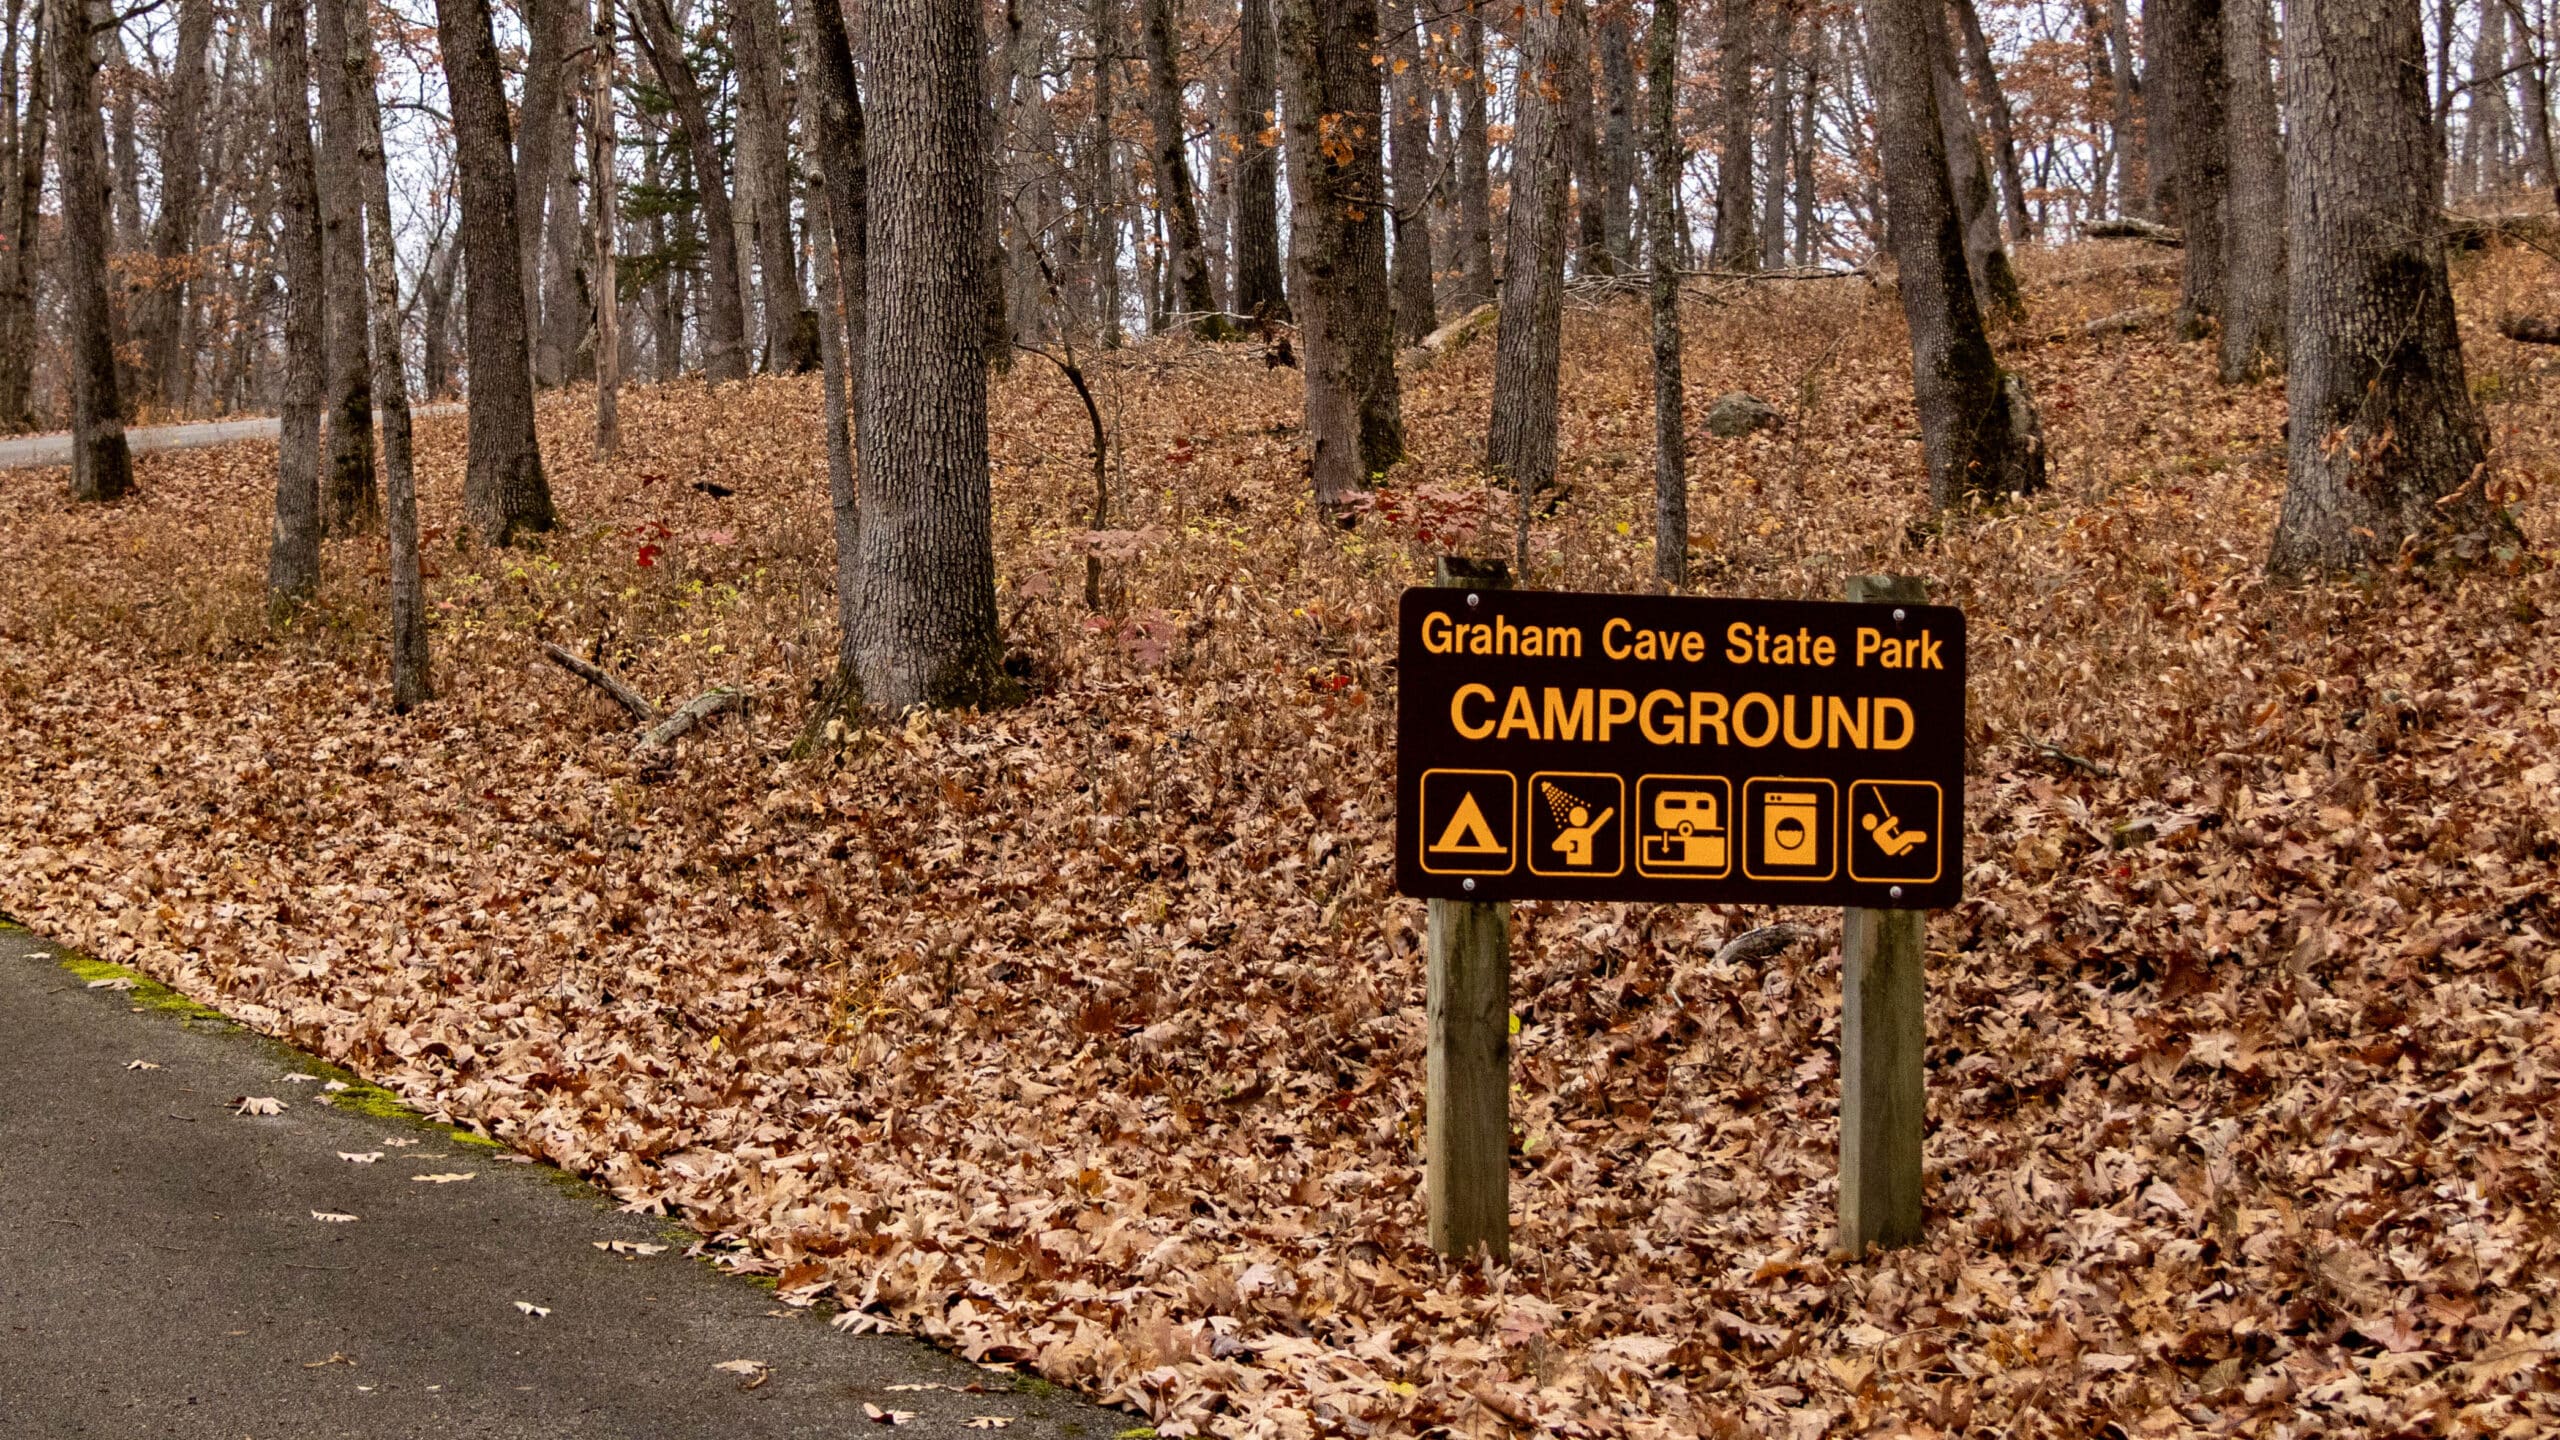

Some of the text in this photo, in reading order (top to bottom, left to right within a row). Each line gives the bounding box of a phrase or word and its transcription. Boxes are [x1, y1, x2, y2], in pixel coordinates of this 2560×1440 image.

[1421, 611, 1944, 670] Graham Cave State Park
[1450, 683, 1915, 750] CAMPGROUND
